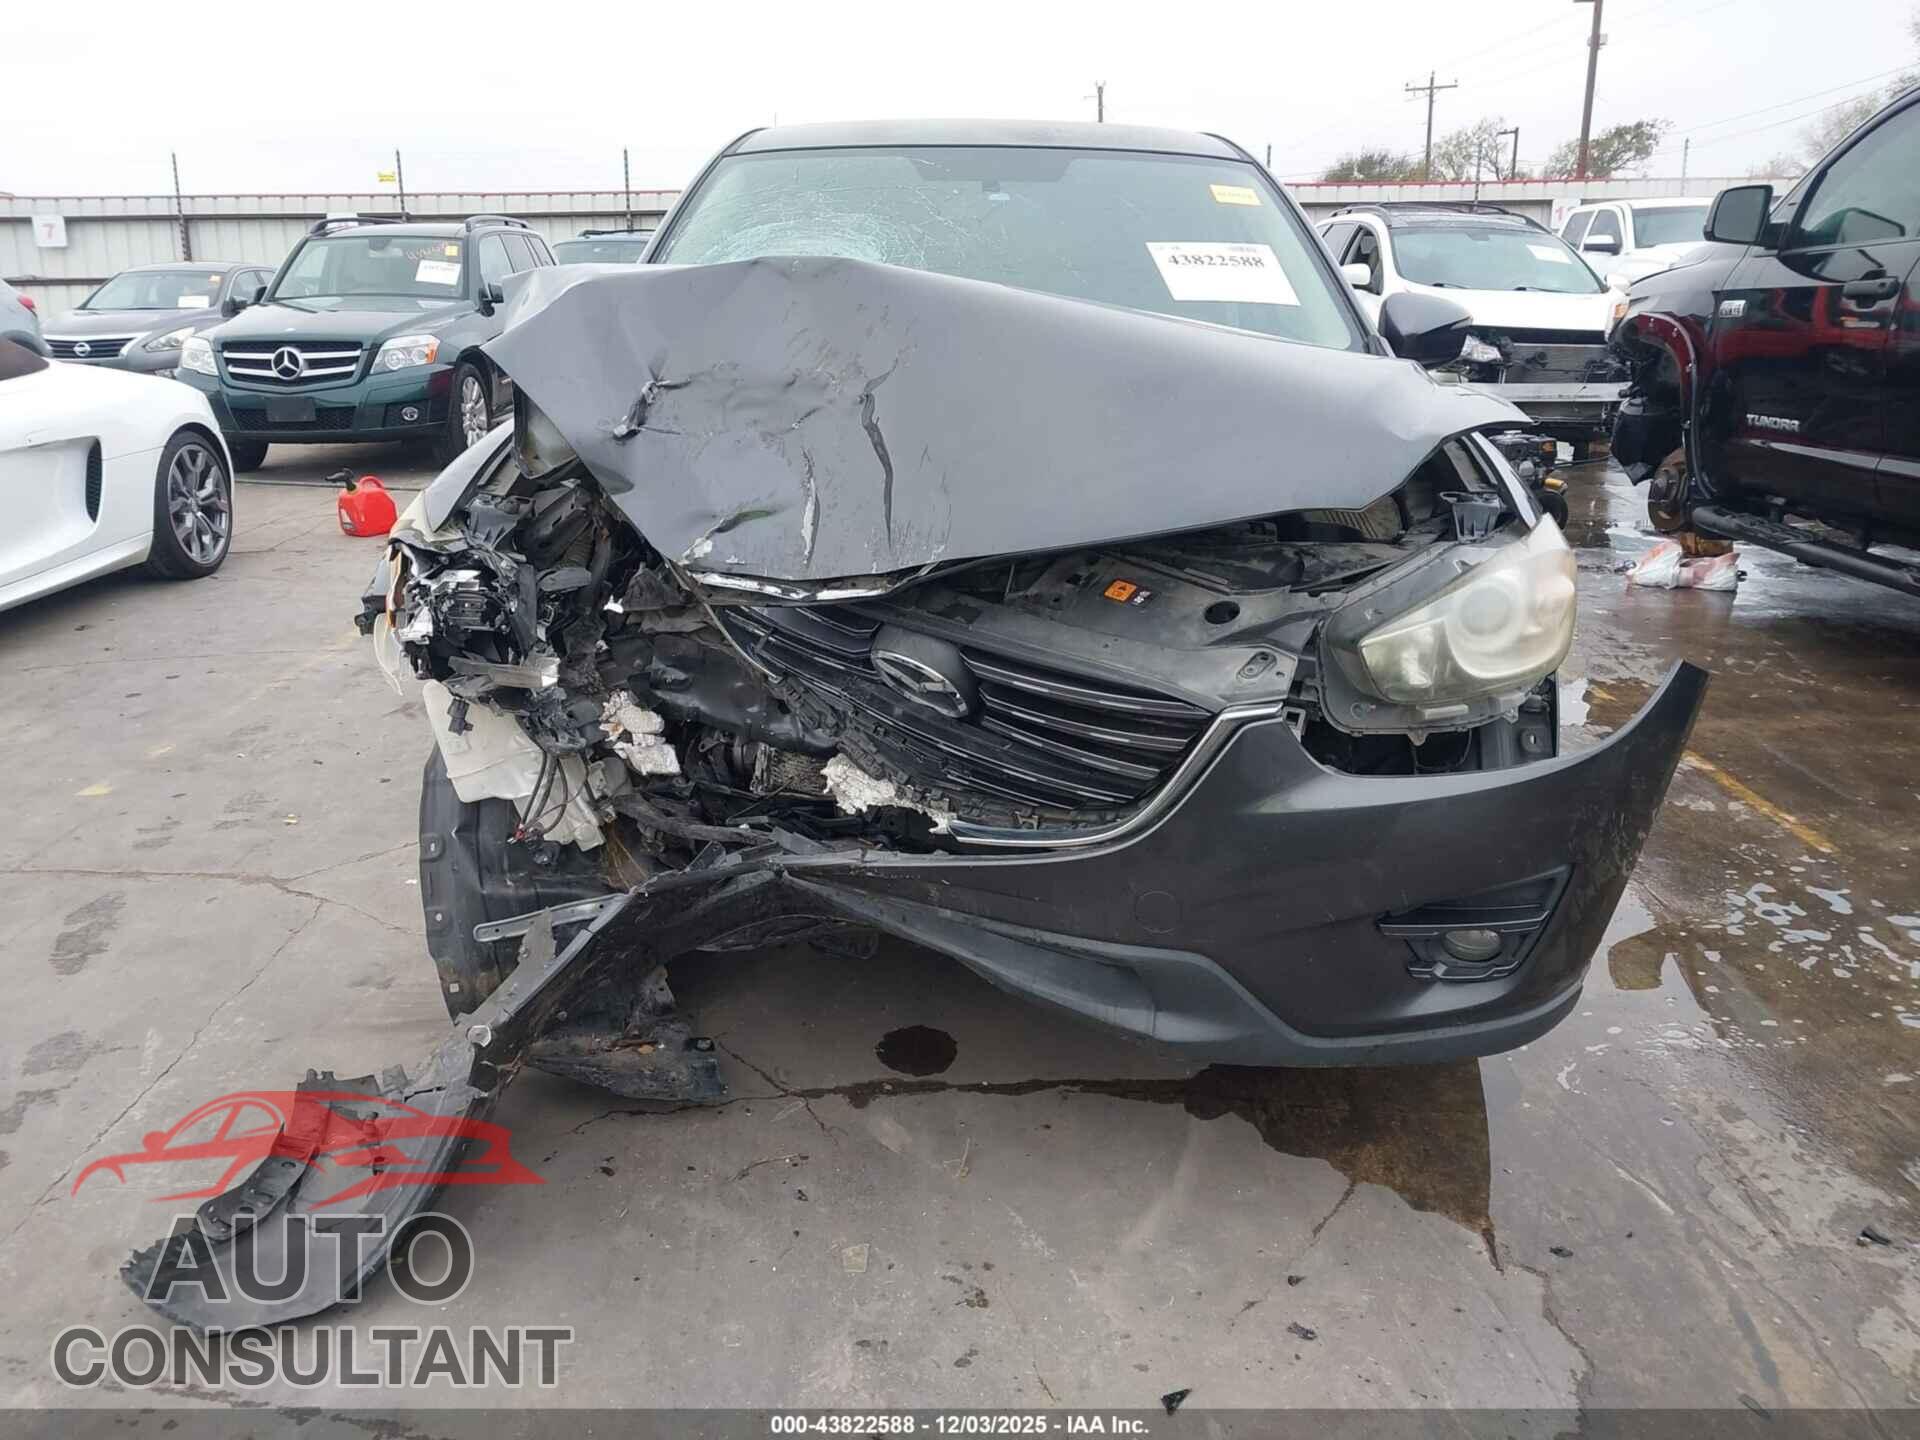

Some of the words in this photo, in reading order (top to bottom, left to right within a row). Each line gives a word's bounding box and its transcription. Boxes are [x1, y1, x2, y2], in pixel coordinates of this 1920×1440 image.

[41, 223, 56, 240] 7
[1168, 253, 1265, 268] 43822588
[1746, 413, 1800, 432] TUNDRA
